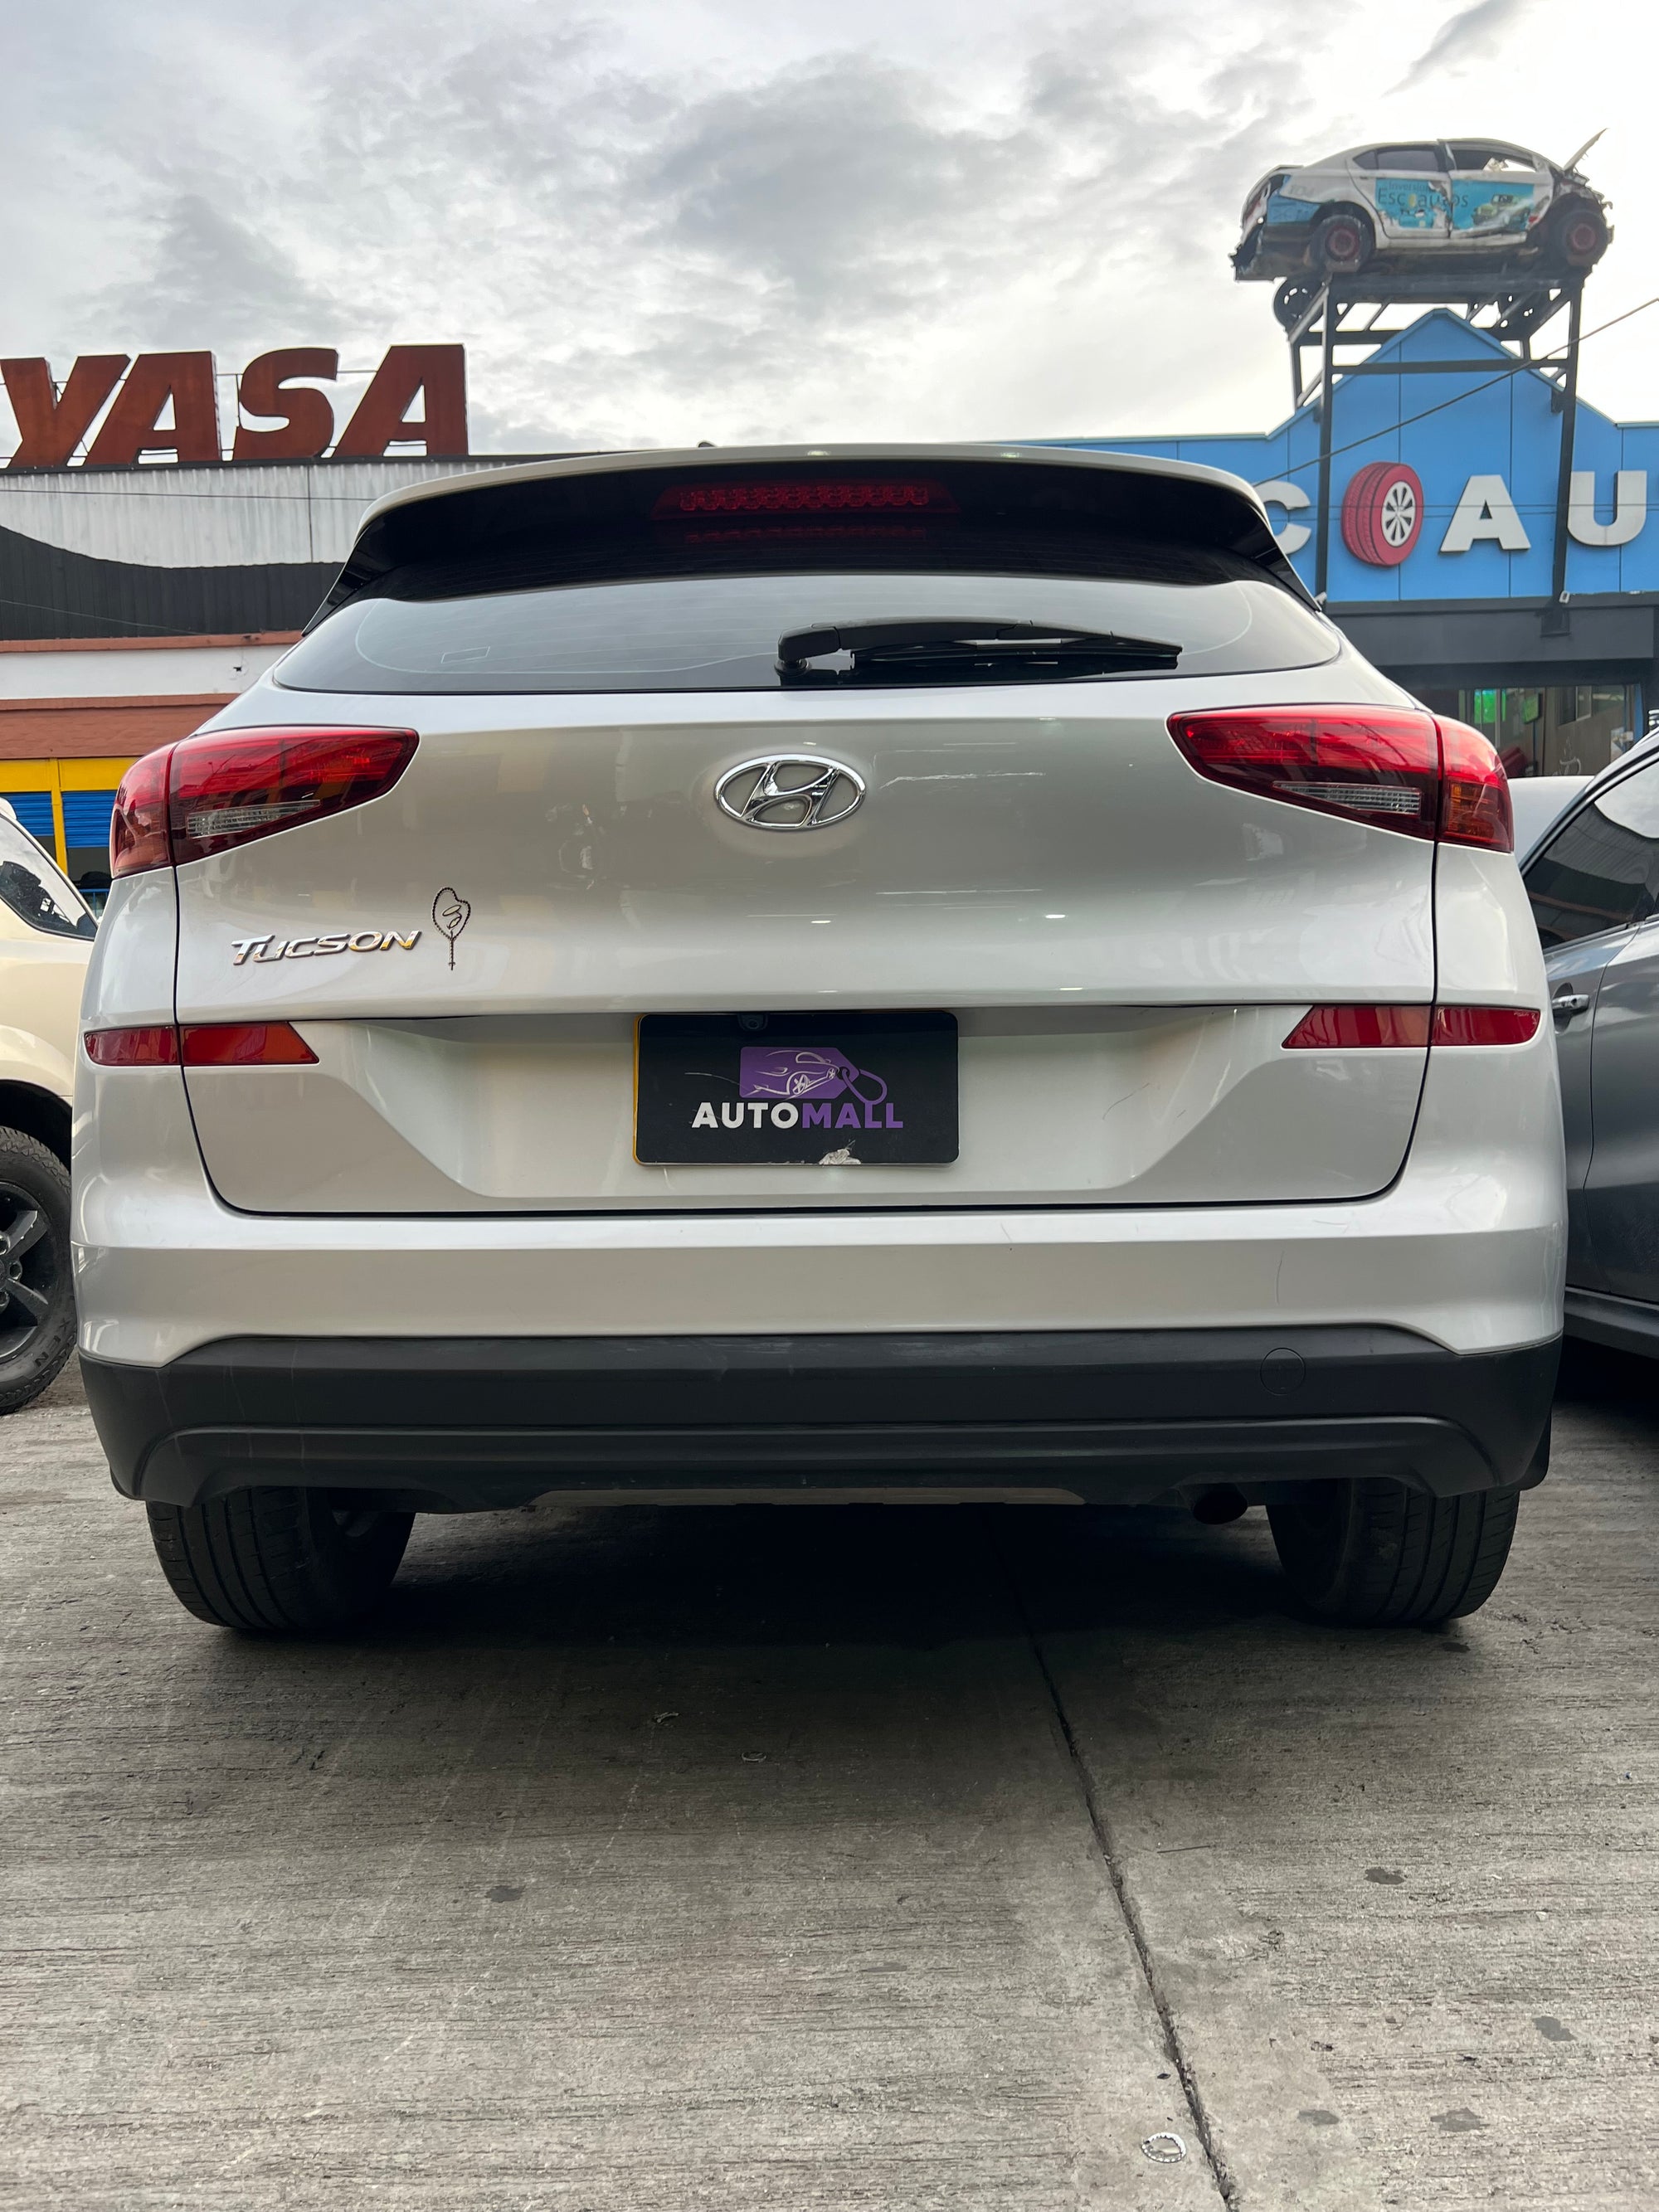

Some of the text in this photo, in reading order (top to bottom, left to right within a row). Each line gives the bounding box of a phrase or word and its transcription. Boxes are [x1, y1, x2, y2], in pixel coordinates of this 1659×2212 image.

[0, 343, 468, 469] YASA
[231, 930, 421, 965] TUCSON
[691, 1101, 904, 1129] AUTOMALL
